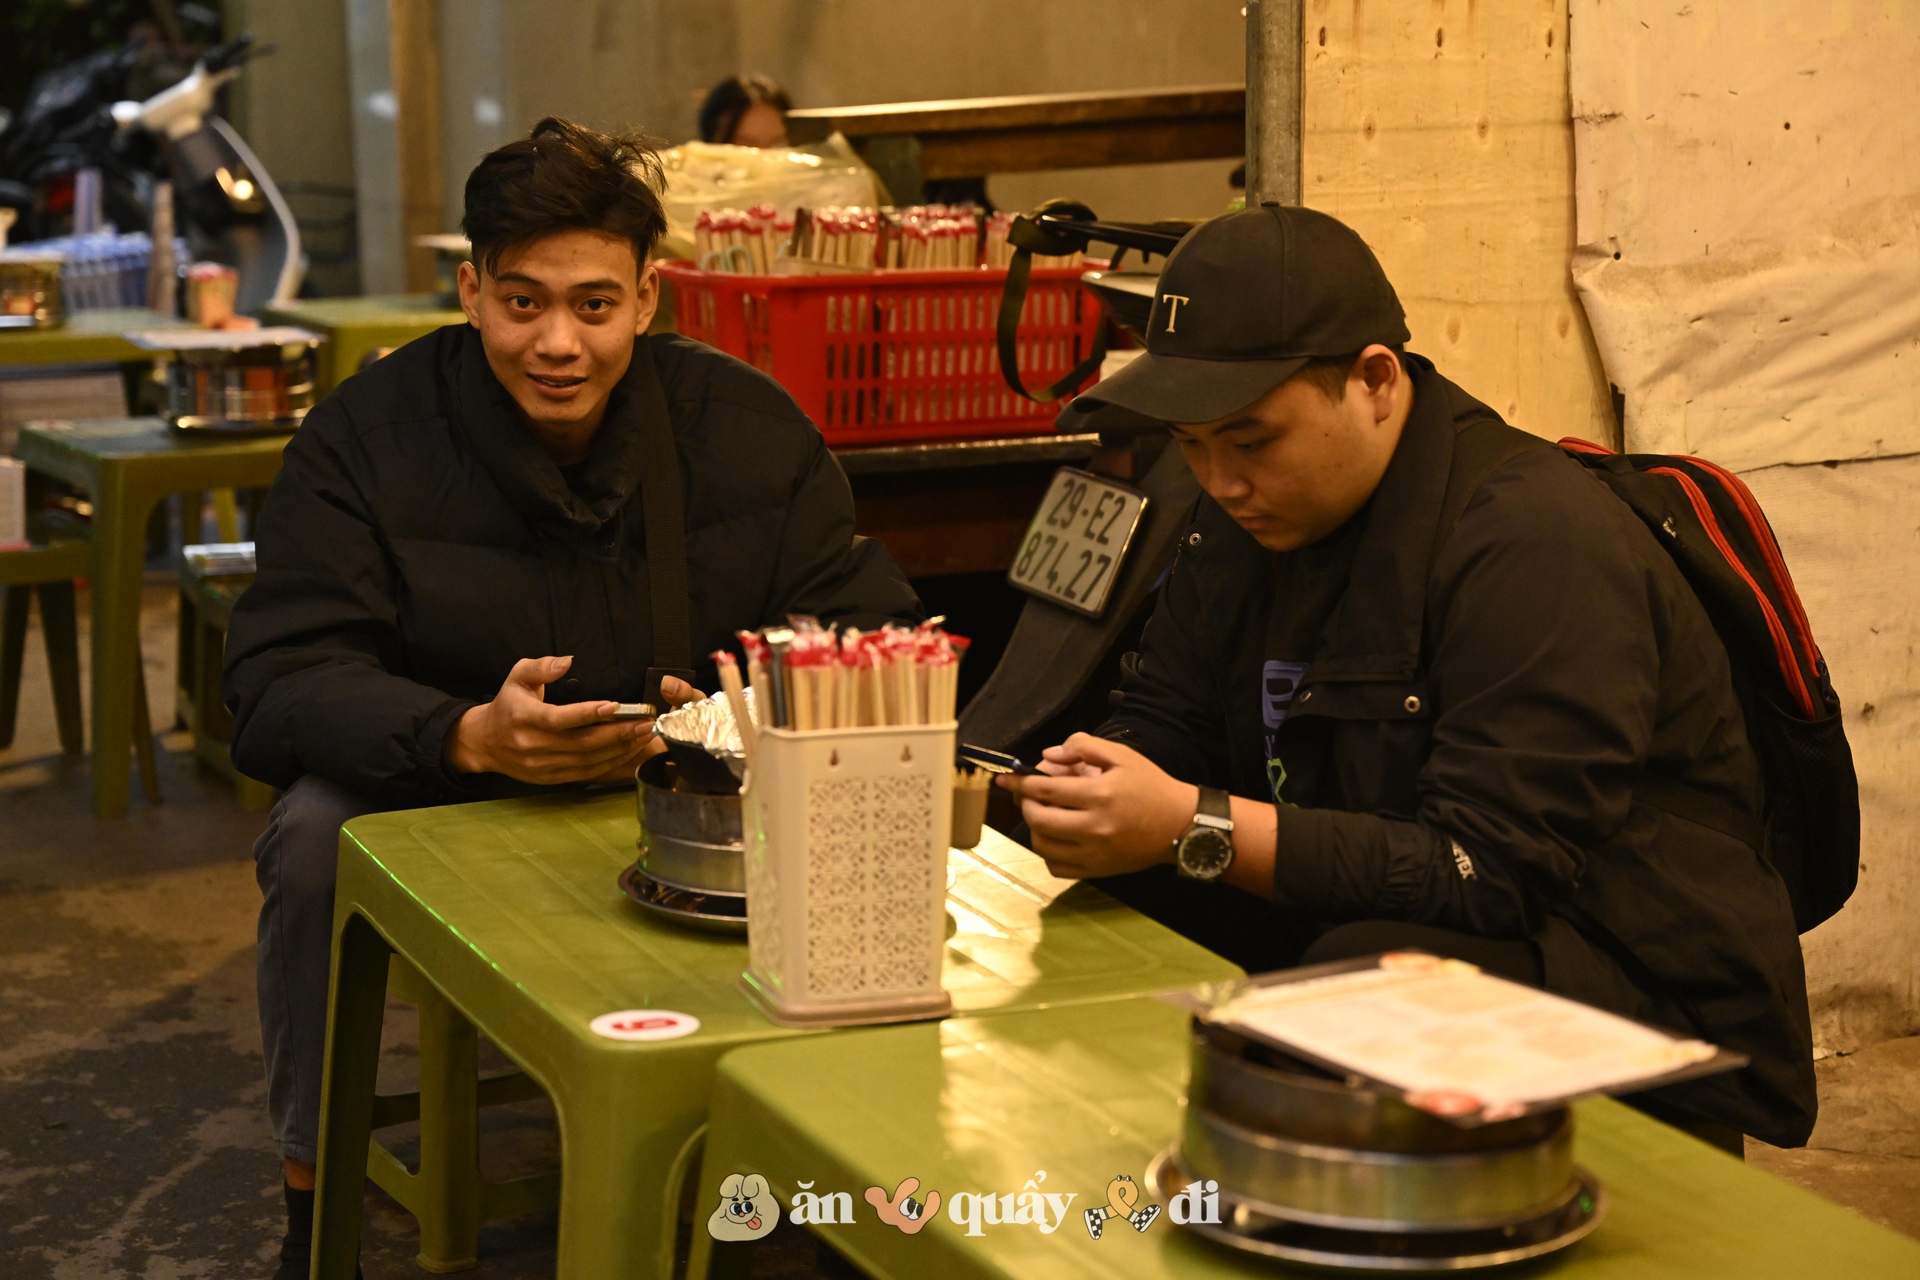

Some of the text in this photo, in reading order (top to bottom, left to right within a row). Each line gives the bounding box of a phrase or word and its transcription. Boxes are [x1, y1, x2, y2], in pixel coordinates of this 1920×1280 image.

[1162, 294, 1190, 333] T
[1046, 477, 1126, 545] 29-E2
[1016, 531, 1112, 604] 874.27
